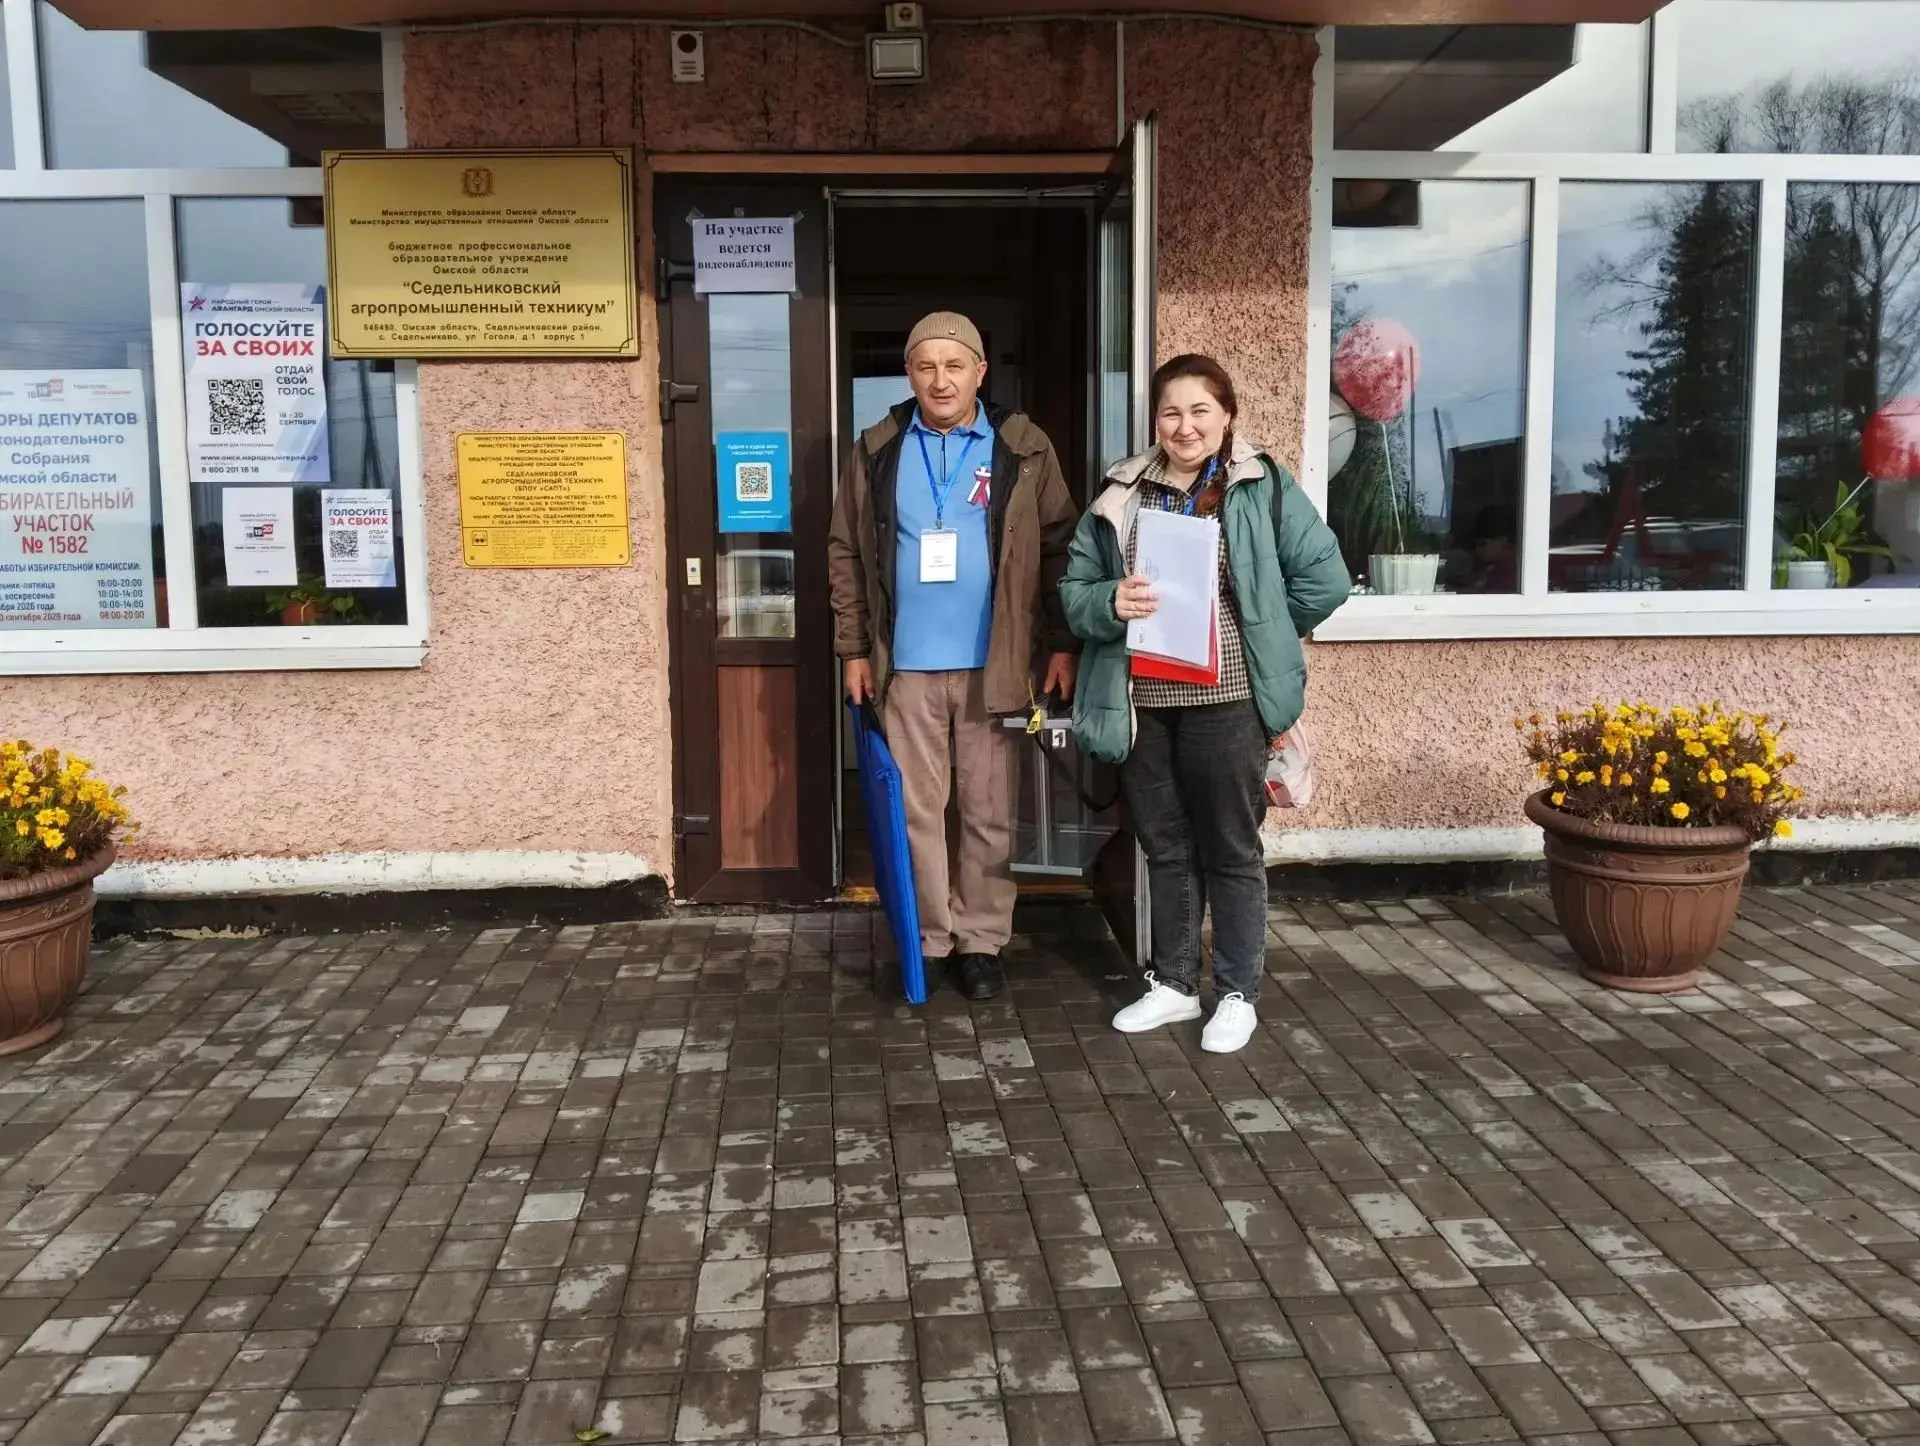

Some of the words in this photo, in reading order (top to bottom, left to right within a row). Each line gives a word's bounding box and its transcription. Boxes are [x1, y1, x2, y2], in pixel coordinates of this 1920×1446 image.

[381, 209, 442, 218] Министерство
[447, 209, 501, 218] образования
[505, 208, 538, 216] Омской
[542, 208, 577, 216] области
[350, 218, 410, 226] Министерство
[414, 218, 483, 226] имущественных
[487, 217, 534, 225] отношений
[538, 217, 571, 225] Омской
[574, 217, 609, 225] области
[705, 223, 725, 236] На
[728, 225, 784, 239] участке
[388, 241, 453, 252] бюджетное
[458, 241, 572, 252] профессиональное
[719, 243, 771, 255] ведется
[392, 253, 494, 265] образовательное
[499, 254, 569, 265] учреждение
[697, 259, 793, 270] видеонаблюдение
[433, 265, 477, 275] Омской
[482, 264, 529, 275] области
[351, 300, 524, 317] агропромышленный
[195, 320, 315, 337] ГОЛОСУЙТЕ
[402, 323, 437, 332] Омская
[485, 323, 568, 332] Седельниковский
[544, 334, 576, 342] корпус
[197, 340, 228, 357] ЗА
[233, 340, 315, 357] СВОИХ
[275, 364, 314, 375] ОТДАЙ
[276, 375, 308, 385] СВОЙ
[278, 387, 316, 396] ГОЛОС
[38, 412, 138, 428] ДЕПУТАТОВ
[0, 435, 125, 448] онодательного
[11, 452, 91, 468] Собрания
[0, 471, 47, 484] мской
[51, 472, 117, 484] области
[0, 487, 134, 511] БИРАТЕЛЬНЫЙ
[329, 507, 389, 516] ГОЛОСУЙТЕ
[13, 514, 95, 533] УЧАСТОК
[329, 517, 345, 526] ЗА
[348, 517, 389, 526] СВОИХ
[22, 536, 44, 554] №
[49, 536, 89, 554] 1582
[28, 562, 94, 572] ИЗБИРАТЕЛЬНОЙ
[5, 593, 56, 601] воскресенье
[37, 604, 55, 612] года
[6, 614, 42, 623] сентября
[1055, 732, 1064, 747] 1
